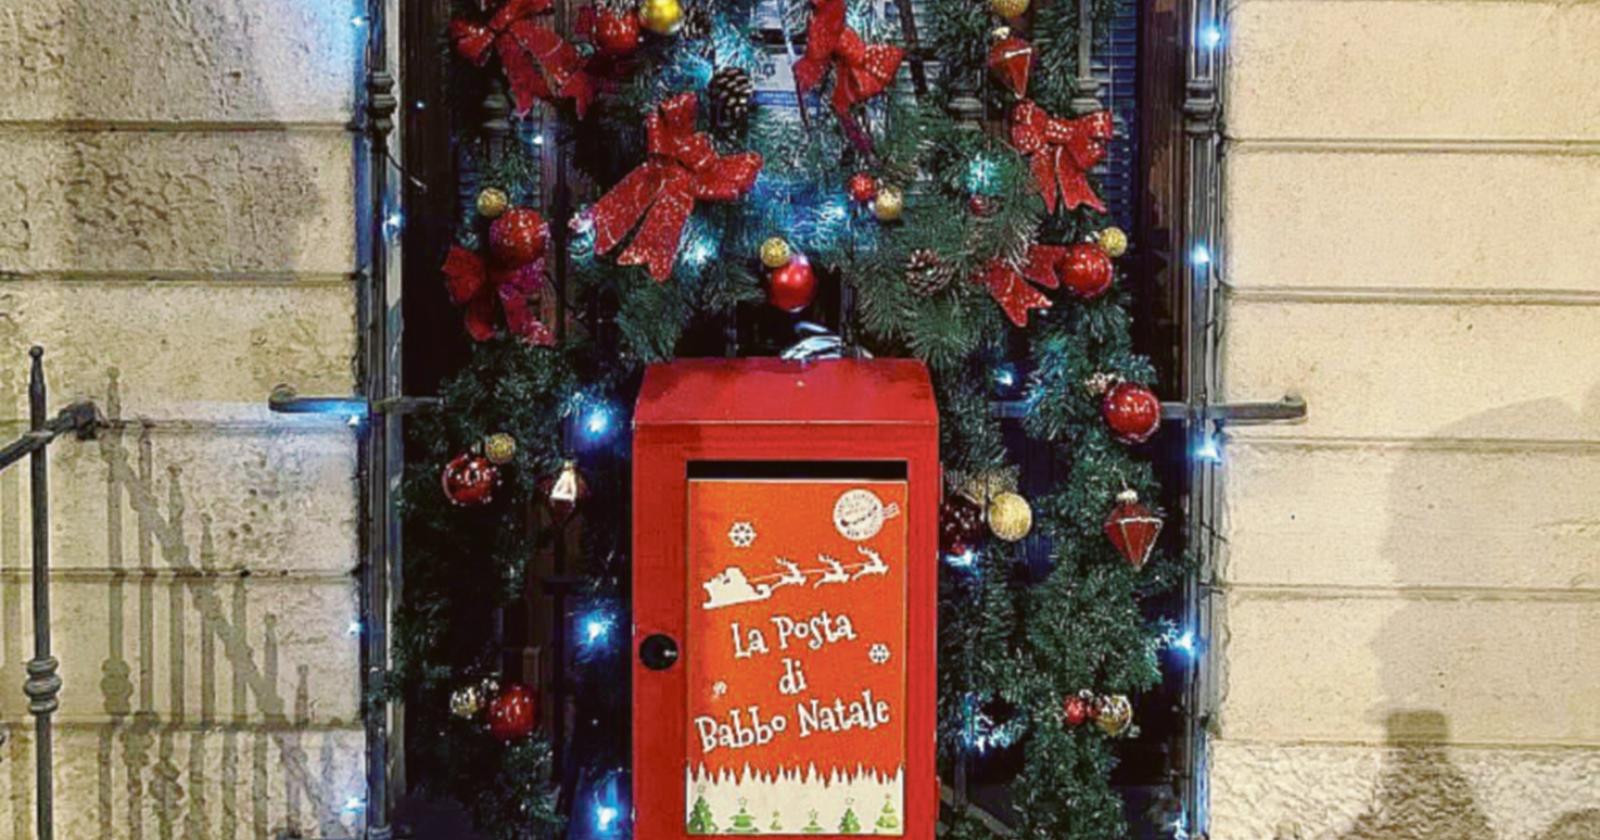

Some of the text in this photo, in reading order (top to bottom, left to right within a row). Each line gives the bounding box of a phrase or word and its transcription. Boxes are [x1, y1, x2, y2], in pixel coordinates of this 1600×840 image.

[731, 611, 856, 657] La Posta
[779, 659, 806, 694] di
[695, 691, 889, 752] Babbo Natale
